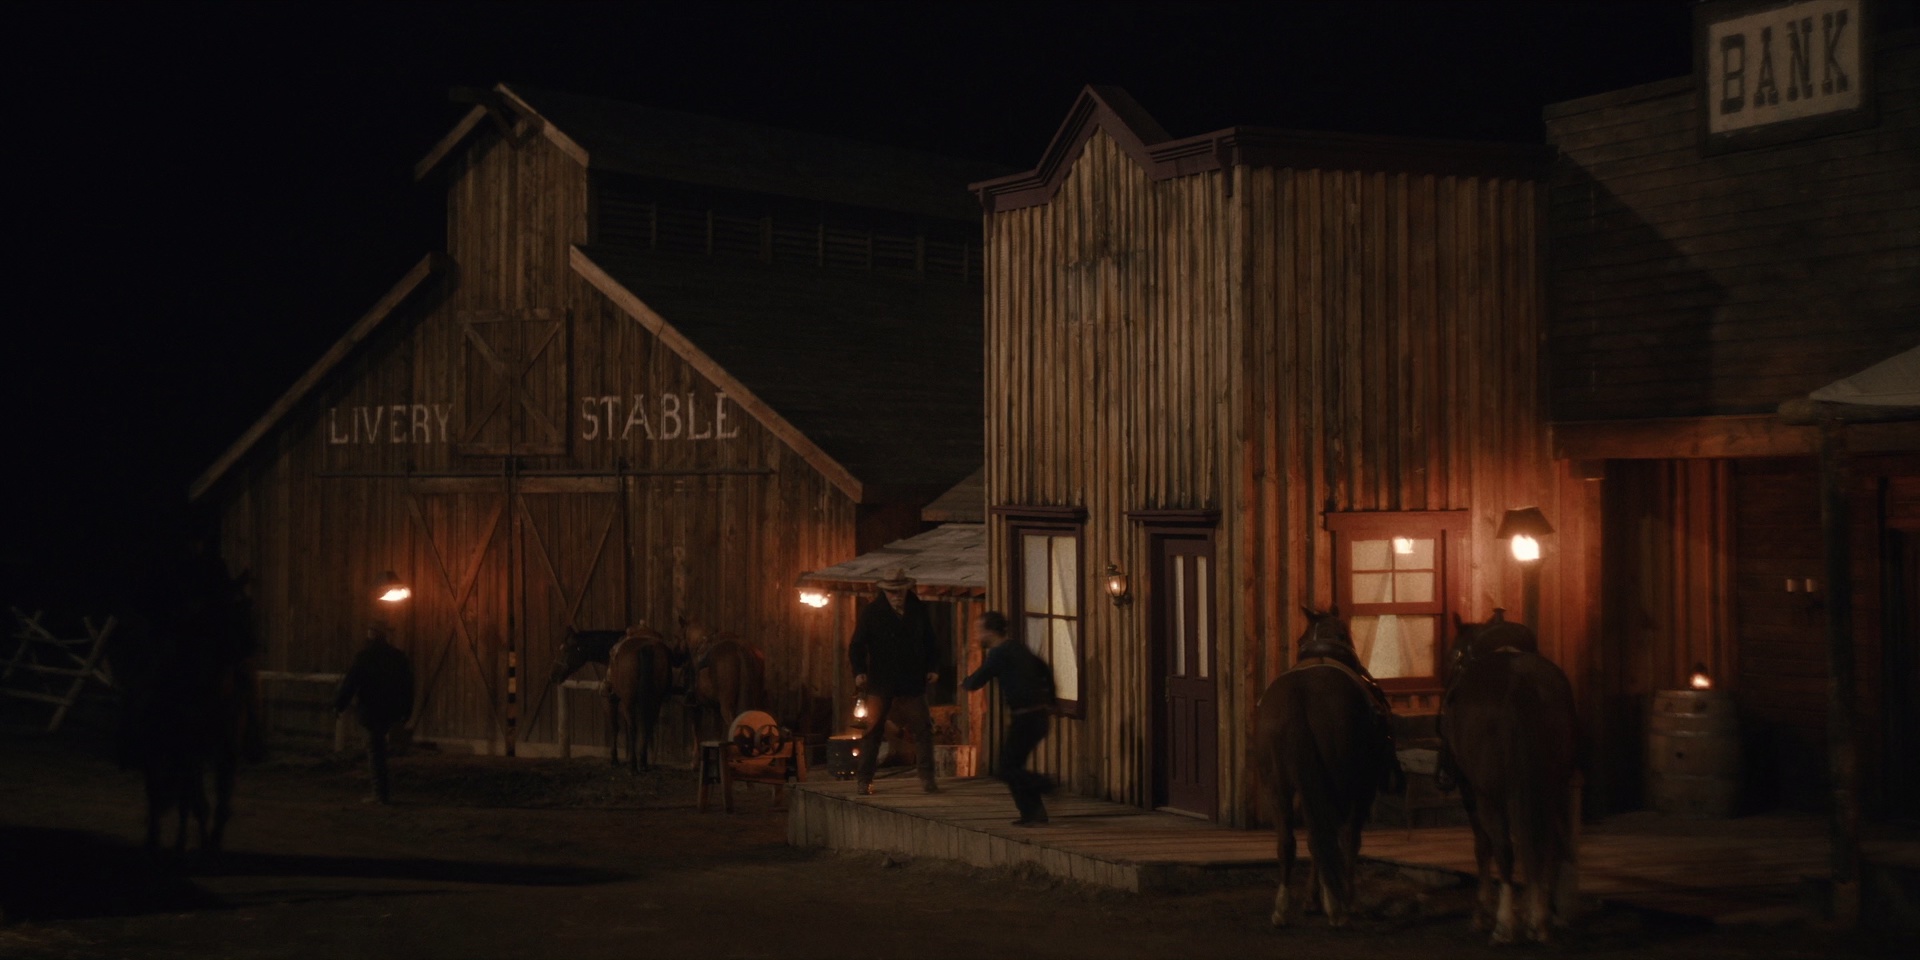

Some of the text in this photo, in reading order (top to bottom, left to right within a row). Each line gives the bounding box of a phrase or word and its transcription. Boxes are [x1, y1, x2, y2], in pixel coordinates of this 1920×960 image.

[1719, 9, 1849, 116] BANK
[328, 392, 741, 445] LIVERY STABLE
